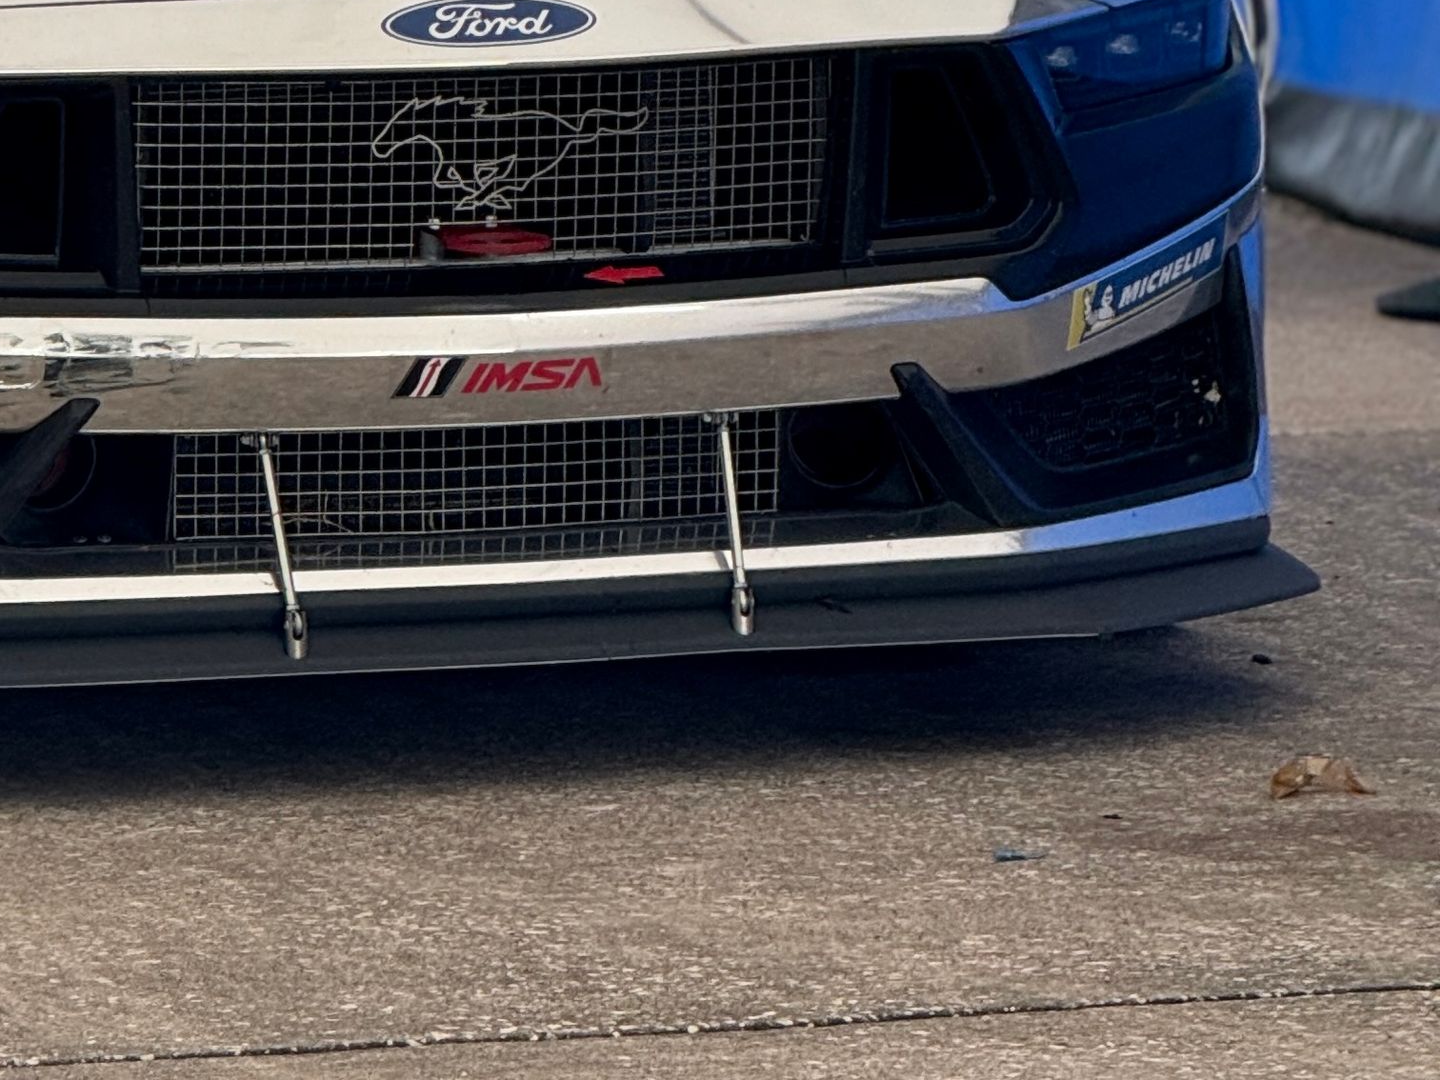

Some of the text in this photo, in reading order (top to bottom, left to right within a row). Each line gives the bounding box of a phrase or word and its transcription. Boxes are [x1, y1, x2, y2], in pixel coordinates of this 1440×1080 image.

[428, 1, 553, 39] Ford
[1118, 237, 1216, 309] MICHELIN
[461, 355, 603, 394] IMSA
